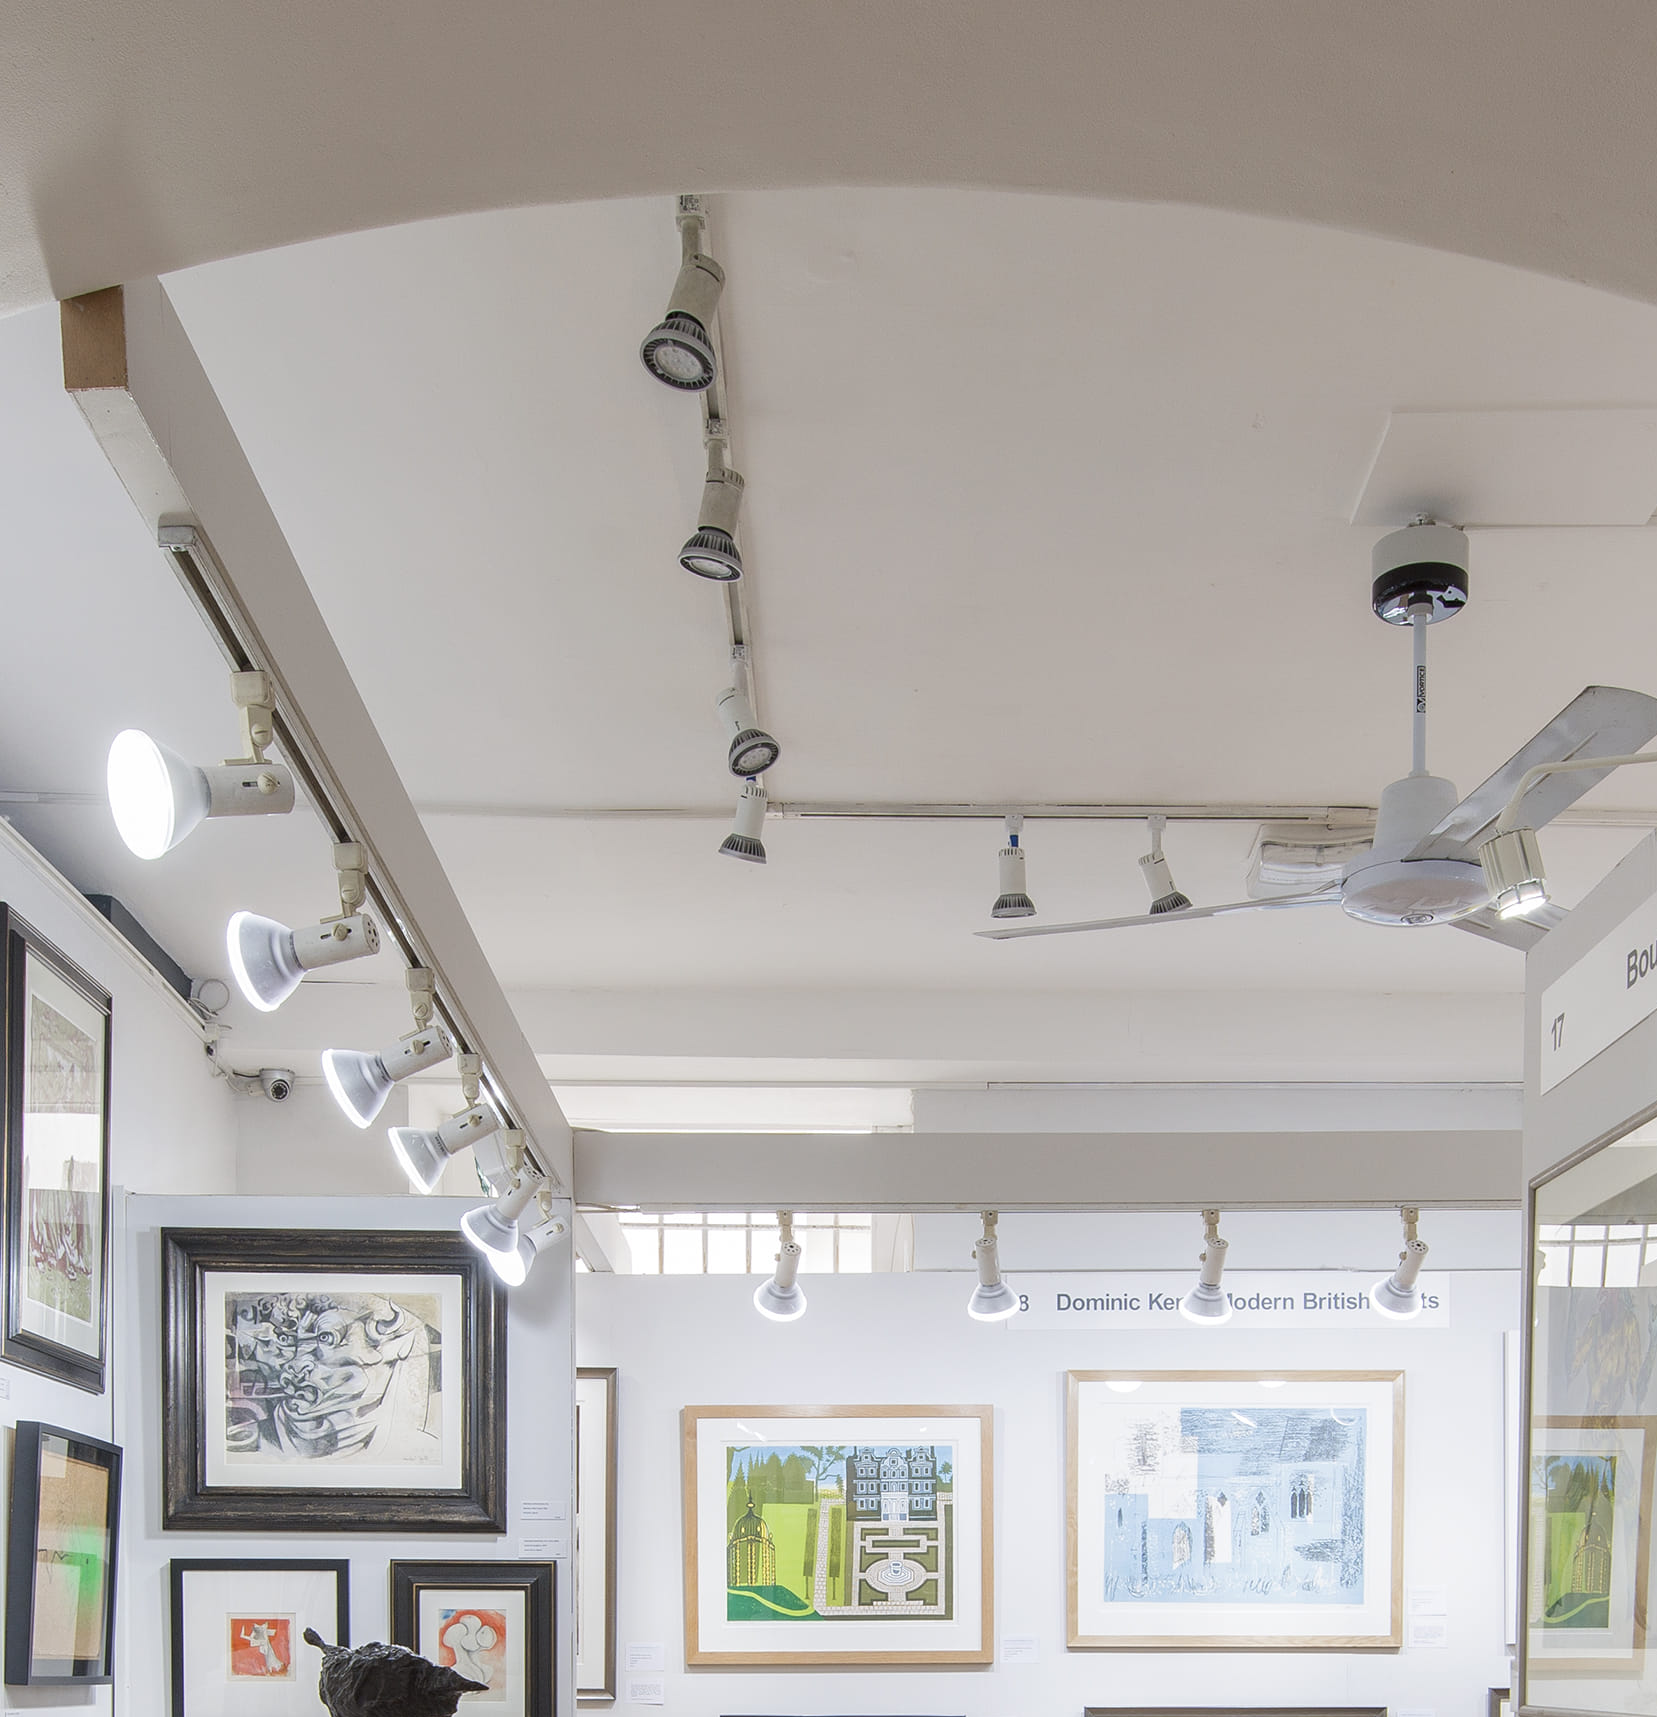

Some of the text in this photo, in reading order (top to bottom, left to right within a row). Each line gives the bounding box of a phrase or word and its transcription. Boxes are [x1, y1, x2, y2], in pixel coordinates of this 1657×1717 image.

[1550, 1013, 1566, 1052] 17
[1056, 1293, 1140, 1311] Dominic
[1303, 1292, 1370, 1310] British
